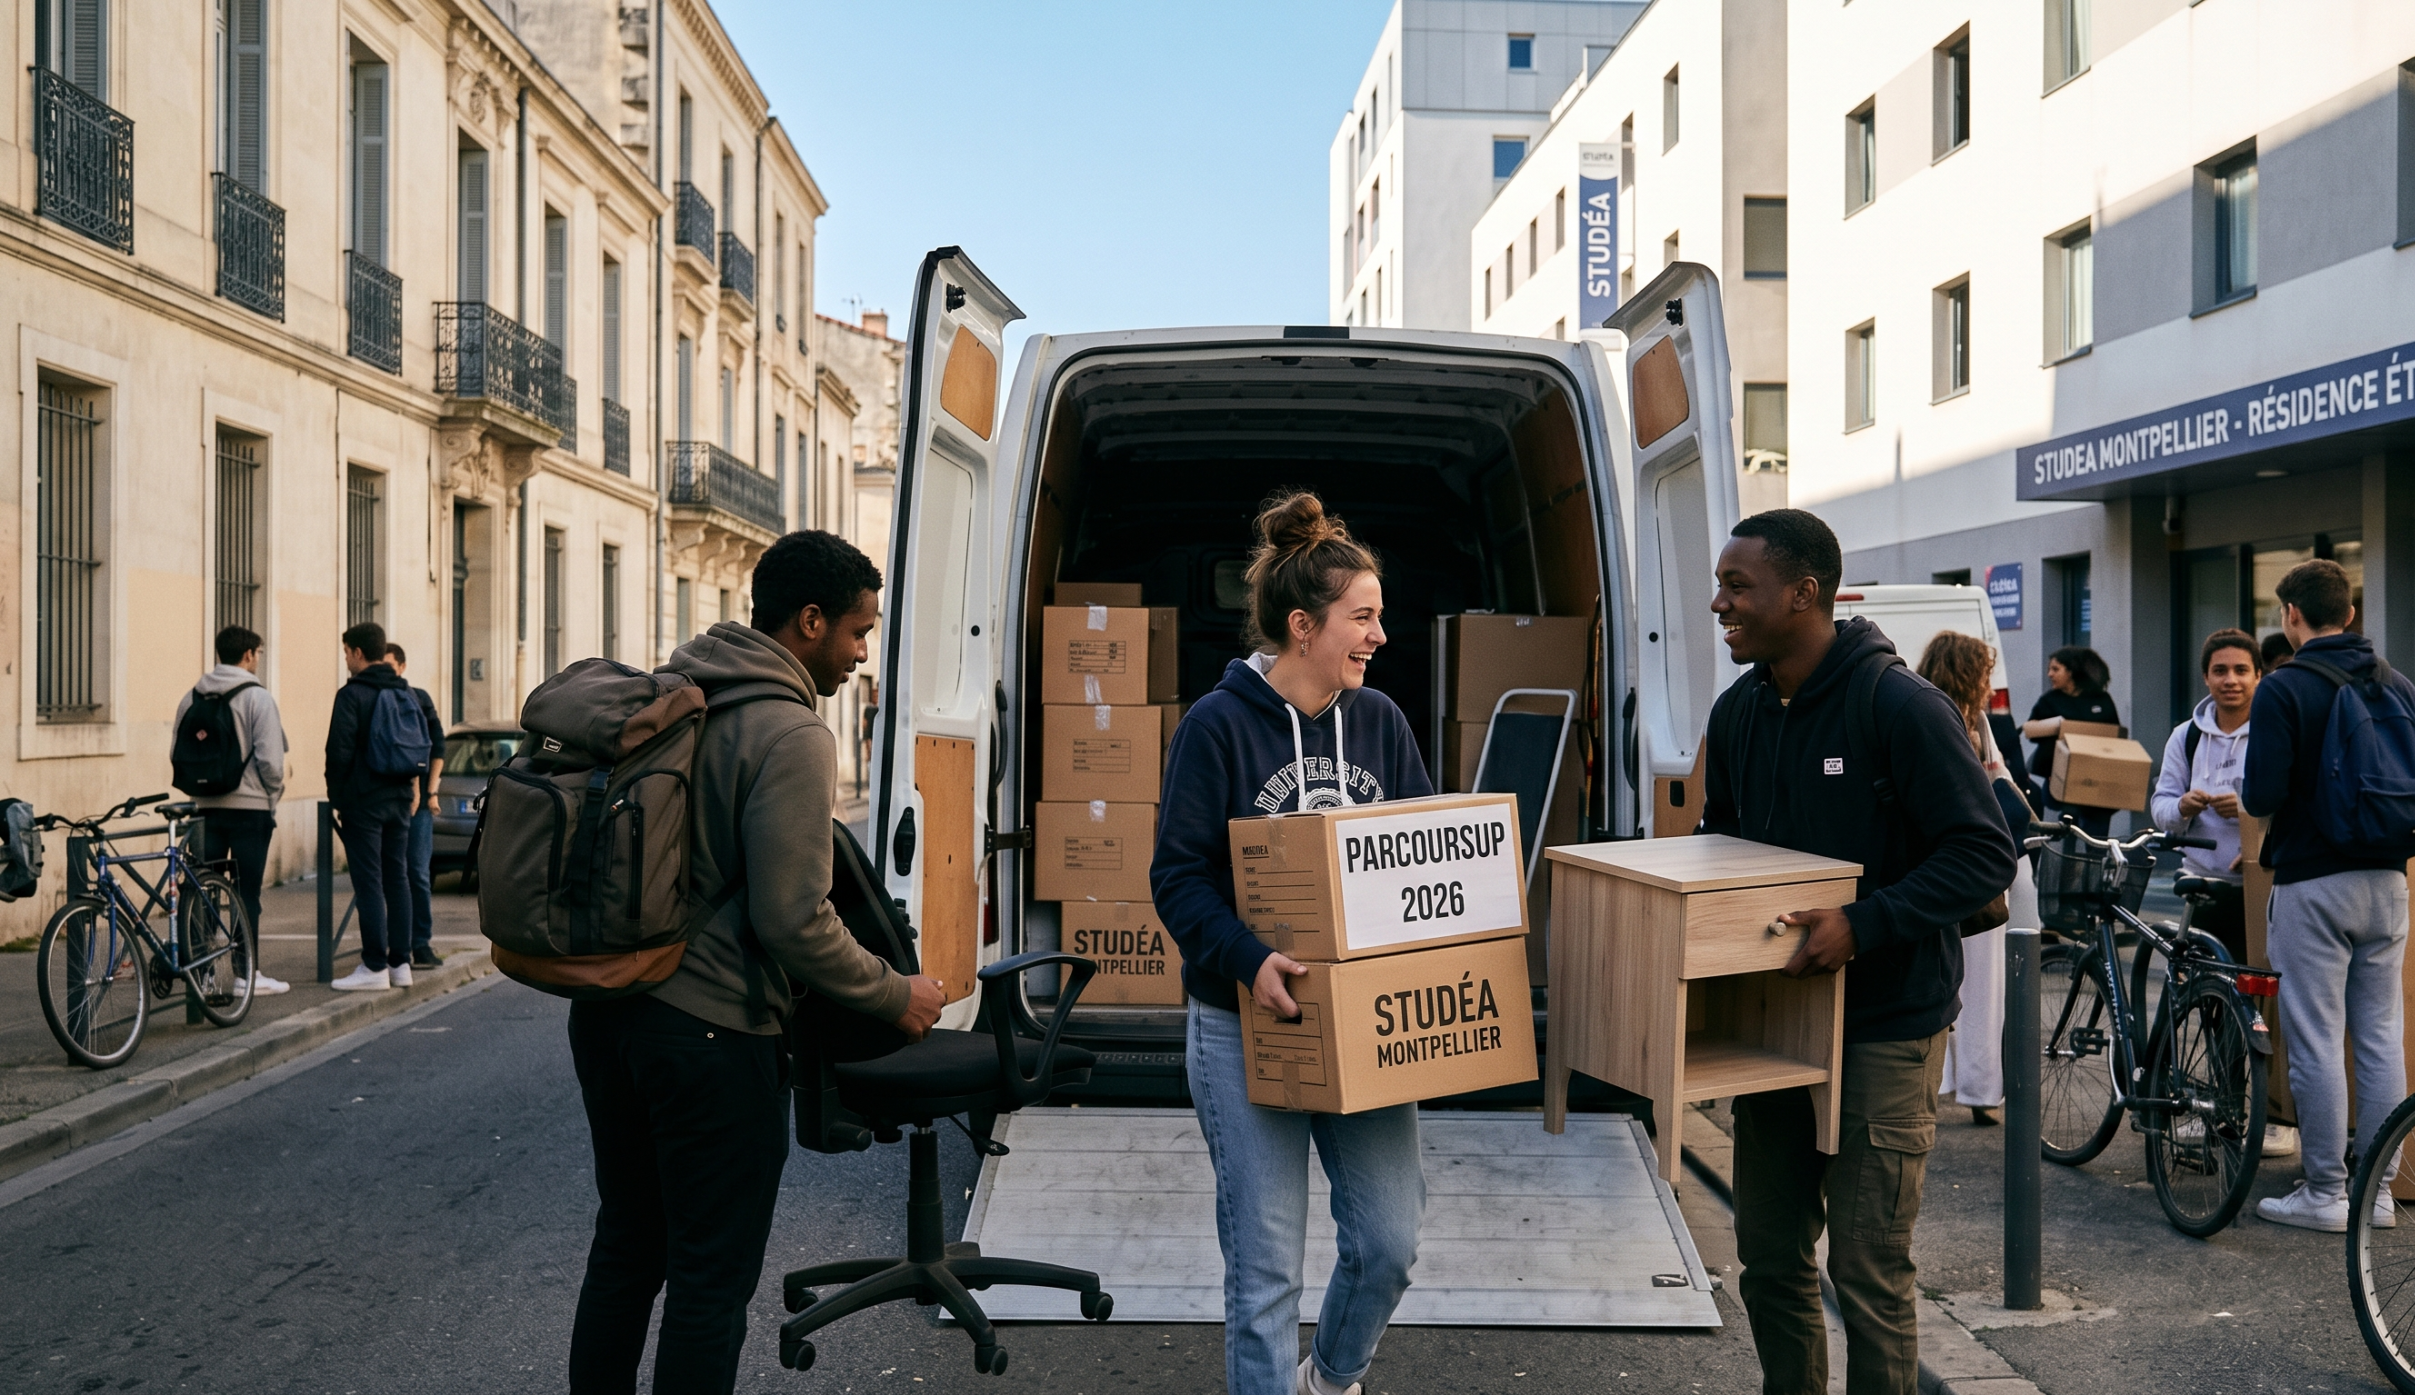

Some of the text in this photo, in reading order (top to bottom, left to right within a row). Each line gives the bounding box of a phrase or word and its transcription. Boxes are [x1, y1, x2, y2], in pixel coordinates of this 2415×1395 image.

[1581, 192, 1611, 298] STUDÉA
[2034, 440, 2098, 485] STUDEA
[2100, 408, 2230, 471] MONTPELLIER
[2248, 369, 2379, 437] RÉSIDENCE
[2386, 351, 2415, 405] ÉT
[1345, 821, 1506, 873] PARCOURSUP
[1401, 880, 1465, 923] 2026
[1073, 924, 1166, 956] STUDÉA
[1093, 959, 1166, 976] NTPELLIER
[1374, 970, 1500, 1037] STUDÉA
[1377, 1025, 1502, 1069] MONTPELLIER
